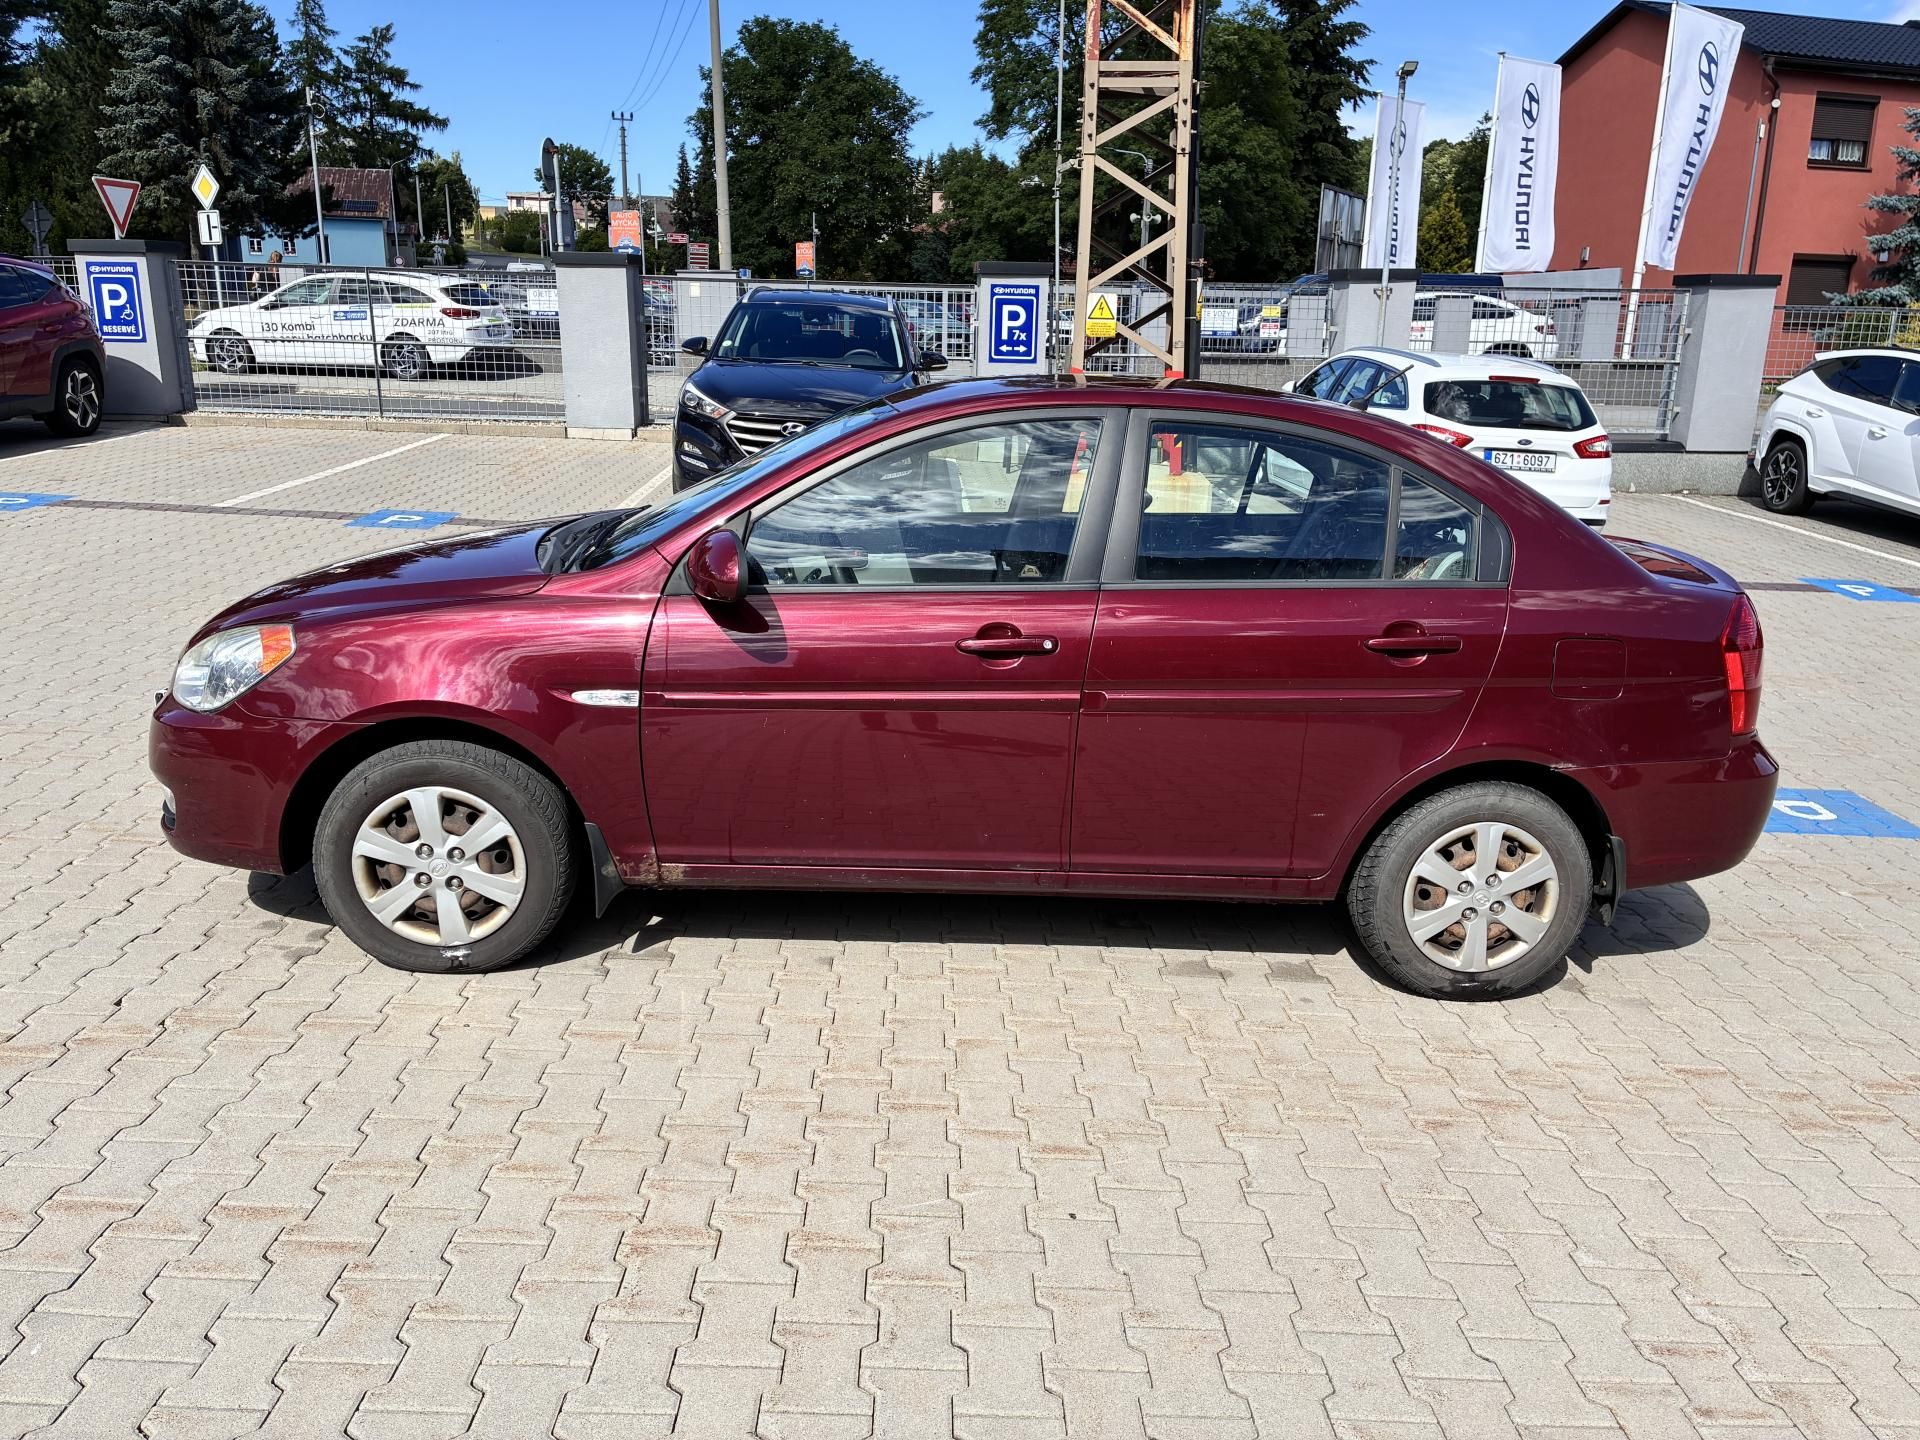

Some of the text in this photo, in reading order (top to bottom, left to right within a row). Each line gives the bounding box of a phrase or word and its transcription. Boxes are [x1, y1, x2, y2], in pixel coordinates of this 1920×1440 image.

[1515, 136, 1535, 250] HYUNDAI
[101, 283, 128, 320] P
[261, 321, 316, 332] i30 Kombi
[393, 317, 446, 328] ZDARMA
[1001, 304, 1027, 340] P
[1012, 330, 1027, 341] 7x
[1494, 452, 1551, 468] 6Z1 6097
